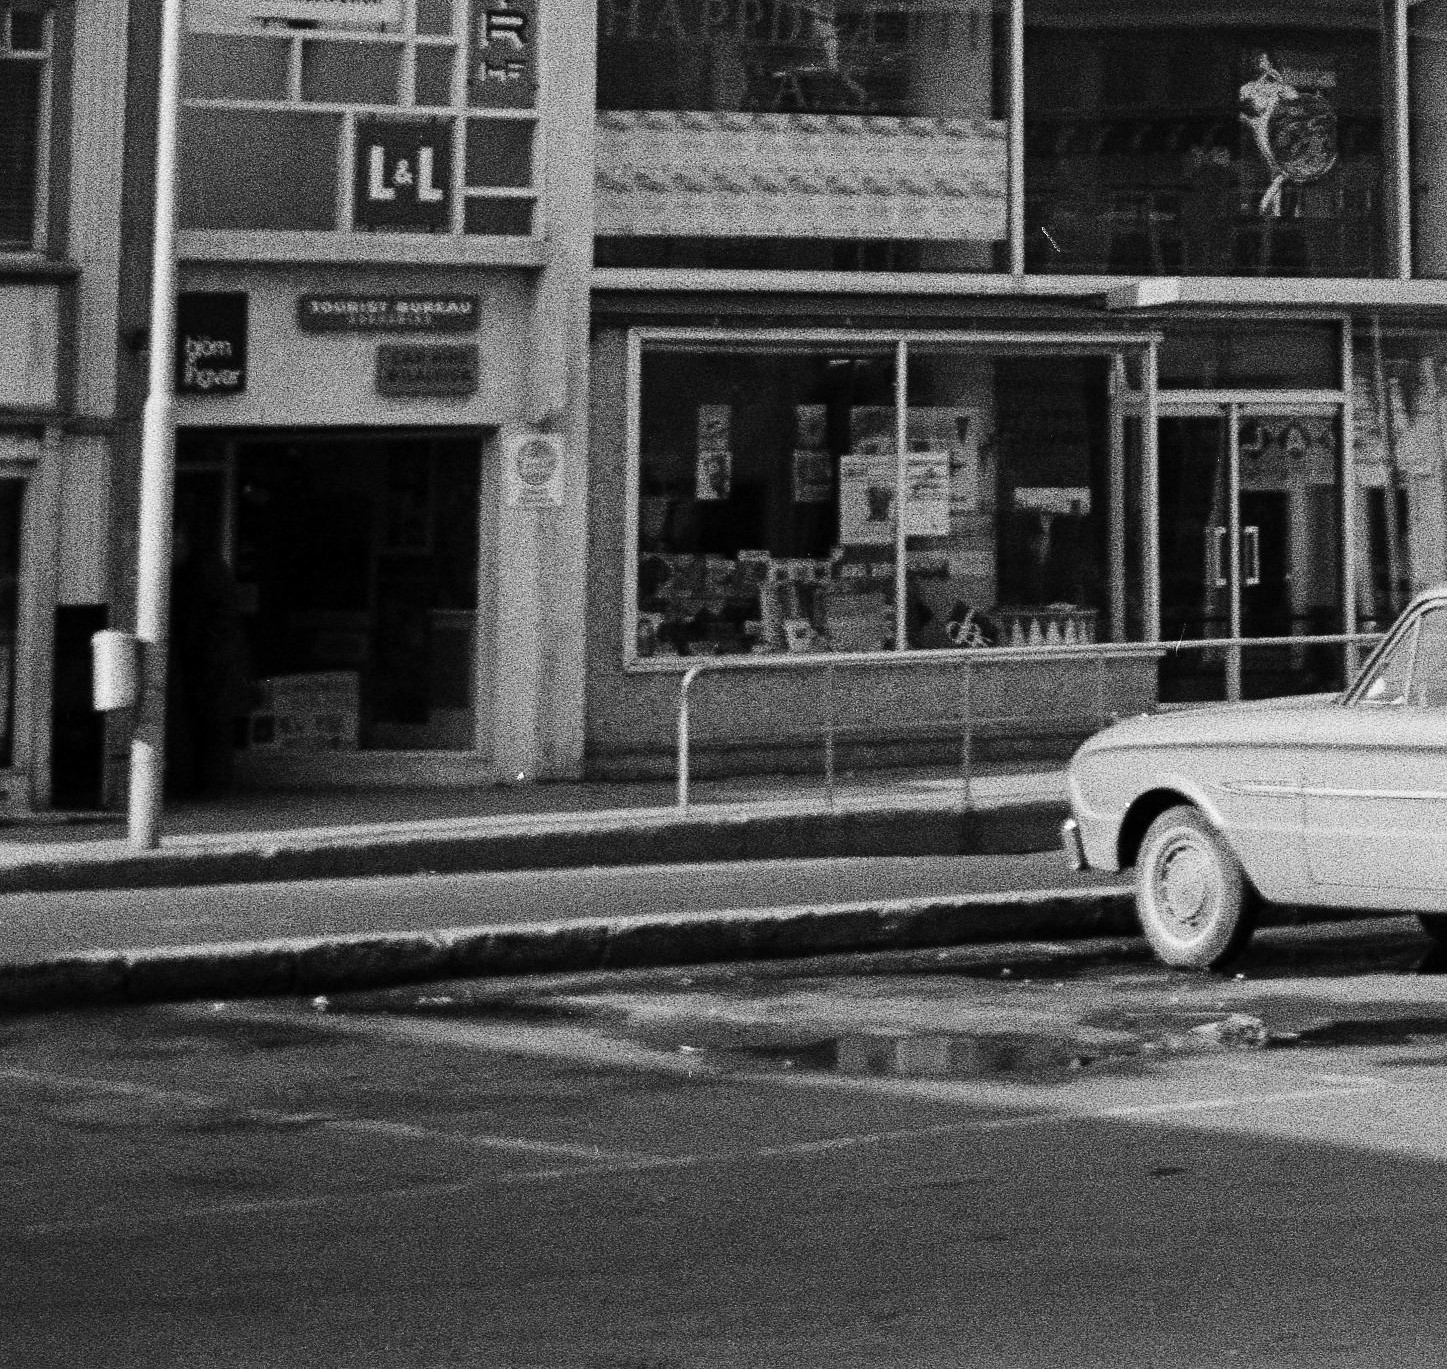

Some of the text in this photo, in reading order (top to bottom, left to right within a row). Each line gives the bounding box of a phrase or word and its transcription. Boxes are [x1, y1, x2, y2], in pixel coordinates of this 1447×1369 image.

[367, 144, 446, 202] L&L
[309, 300, 473, 315] TOURIST BUREAU
